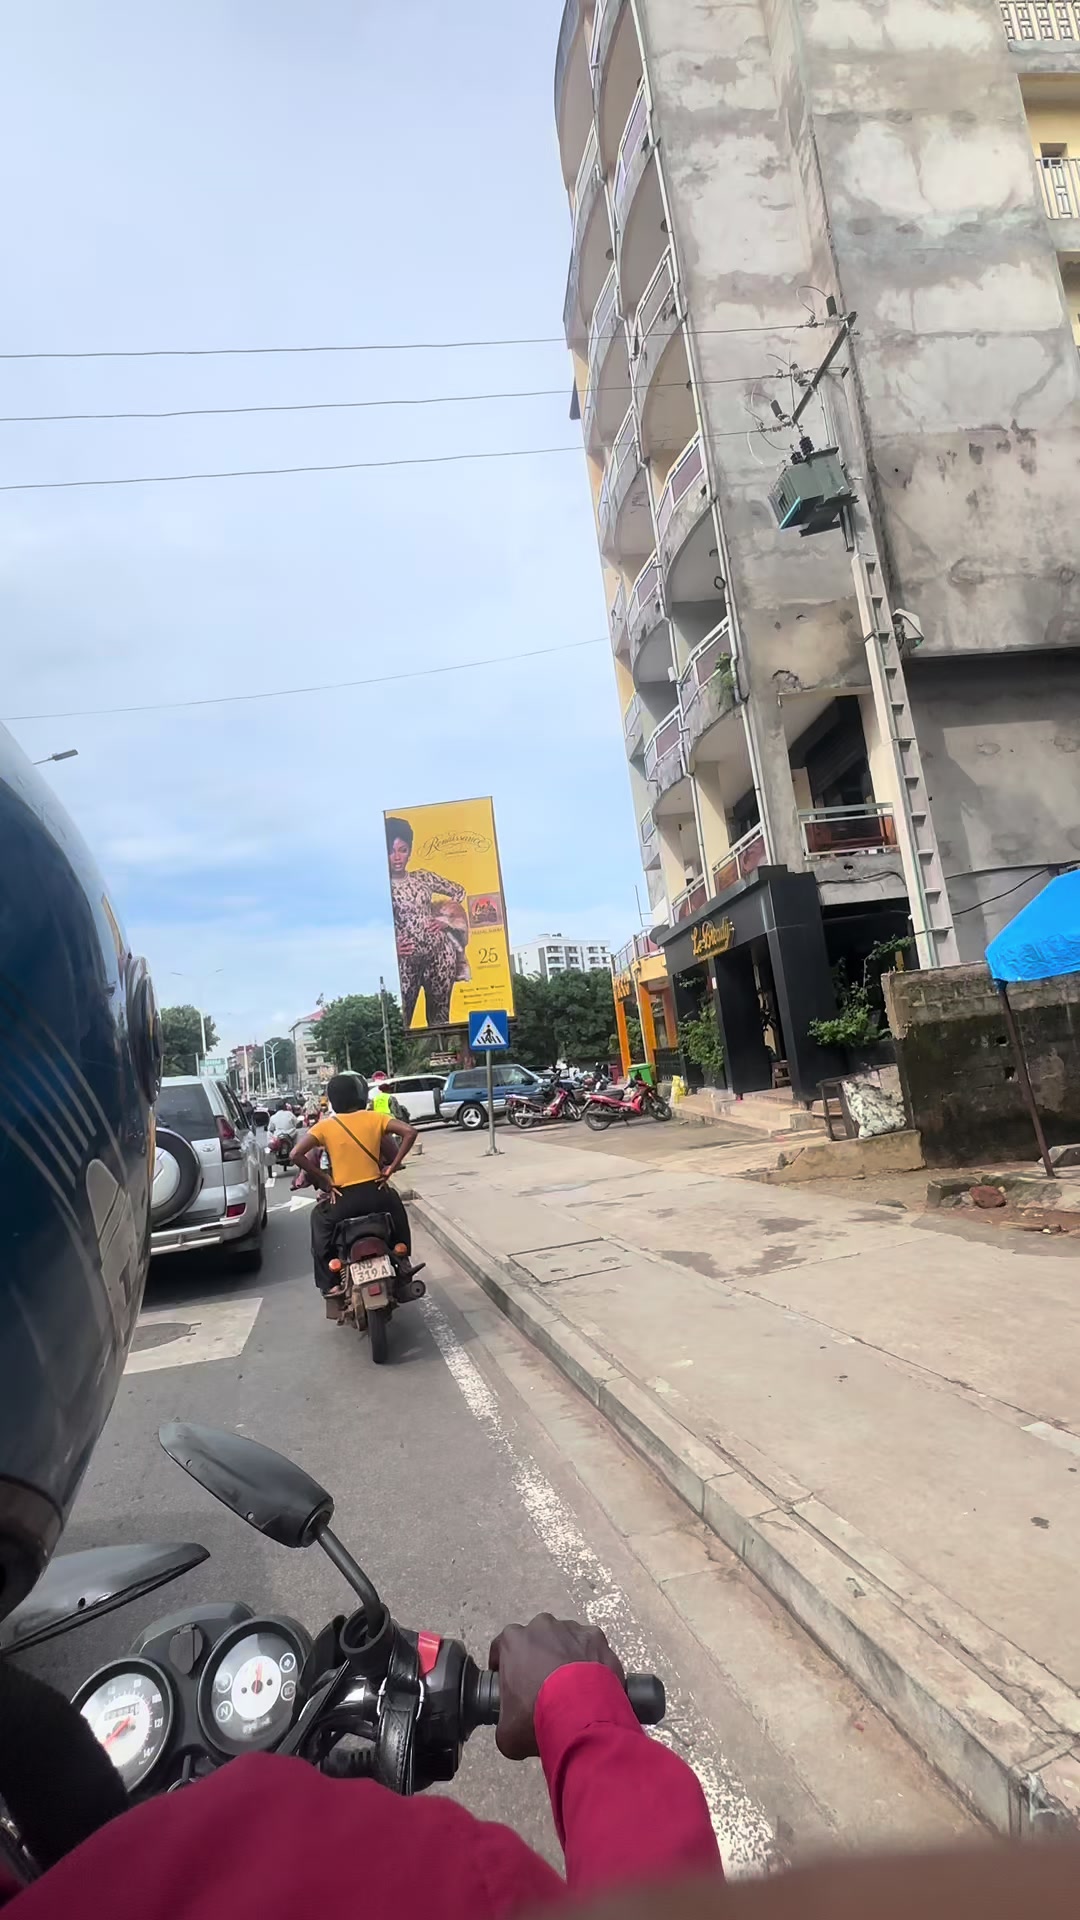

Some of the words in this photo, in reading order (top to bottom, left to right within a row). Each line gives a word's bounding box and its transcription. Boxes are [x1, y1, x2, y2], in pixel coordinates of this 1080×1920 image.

[420, 831, 489, 859] Renaissance
[478, 947, 498, 964] 25
[357, 1268, 378, 1281] 319
[381, 1265, 389, 1275] A
[220, 1706, 229, 1717] N
